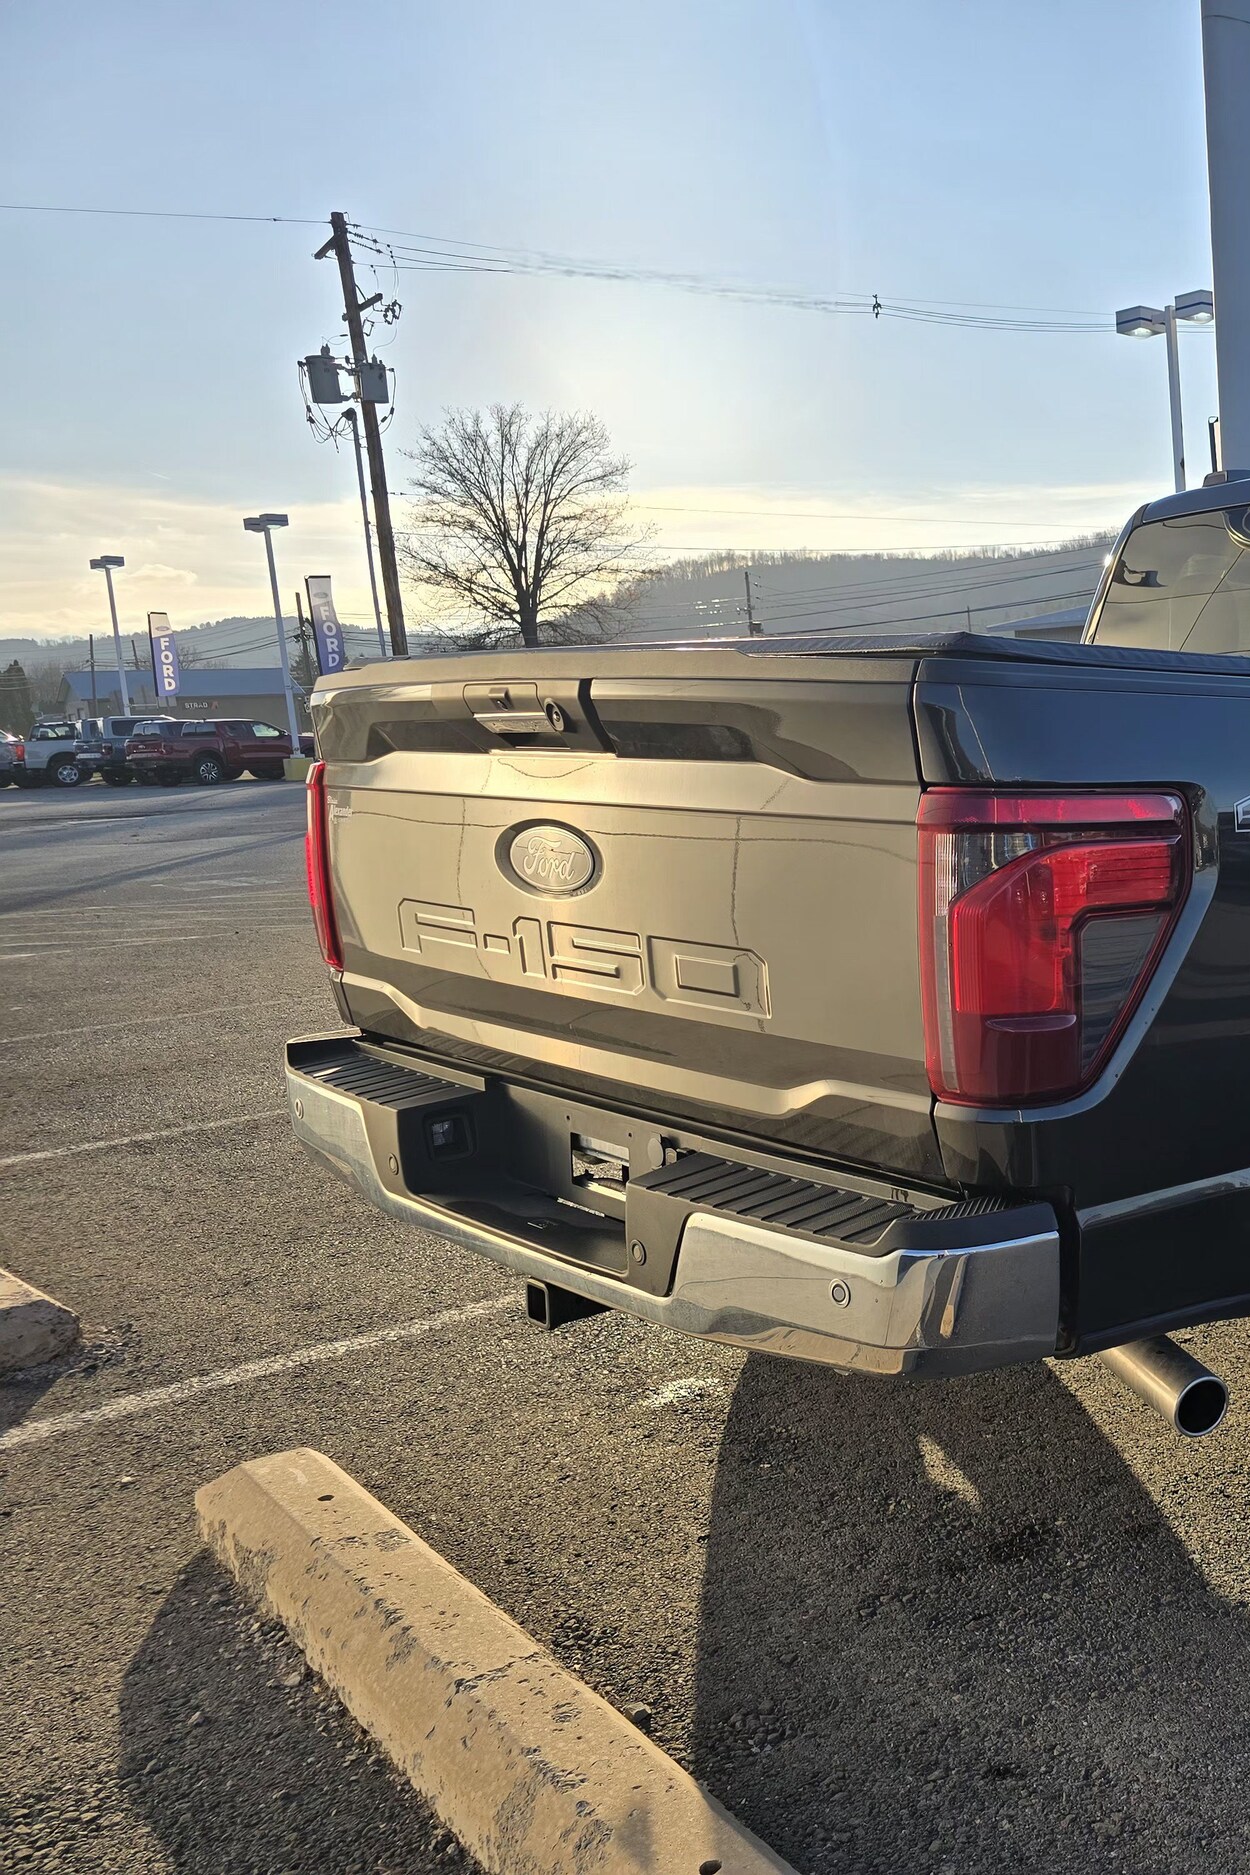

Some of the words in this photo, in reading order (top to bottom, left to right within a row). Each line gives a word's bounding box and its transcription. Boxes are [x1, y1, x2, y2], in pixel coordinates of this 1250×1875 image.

[160, 637, 176, 691] FORD
[320, 606, 340, 668] FORD
[523, 836, 575, 880] Ford
[398, 898, 773, 1019] F-150
